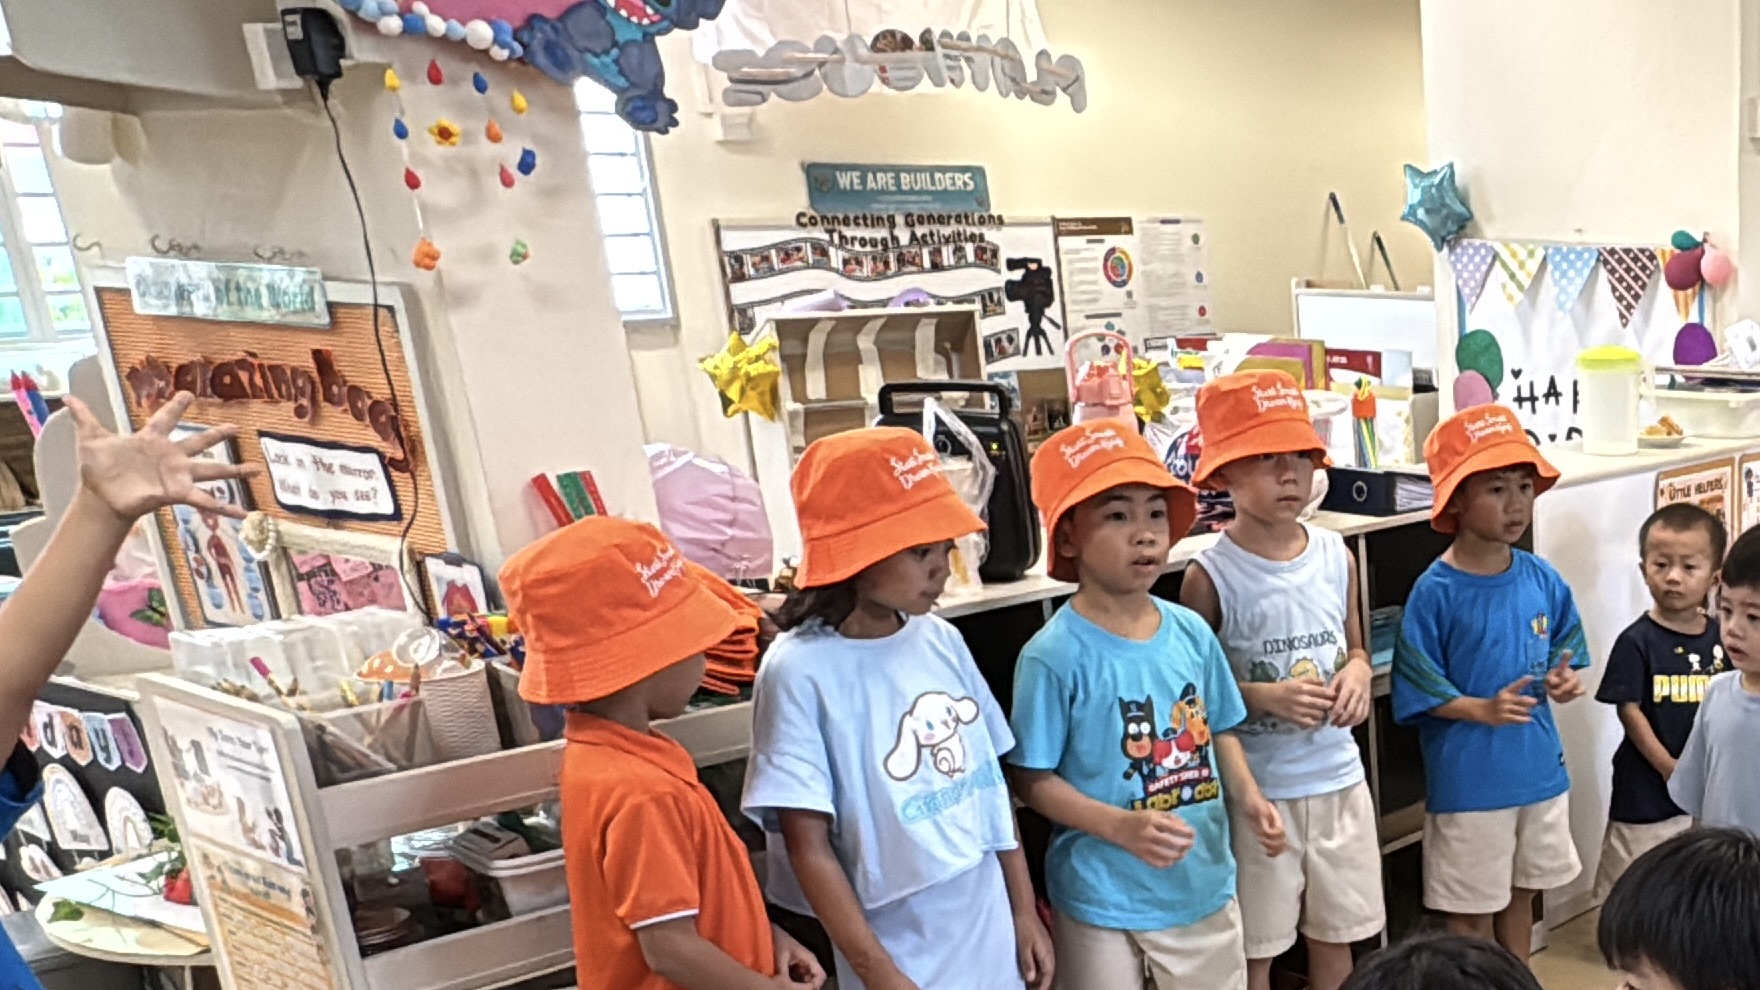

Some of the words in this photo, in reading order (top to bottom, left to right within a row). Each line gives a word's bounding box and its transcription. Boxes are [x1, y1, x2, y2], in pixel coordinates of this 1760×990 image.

[835, 171, 862, 191] WE
[866, 171, 898, 191] ARE
[900, 171, 976, 192] BUILDERS
[795, 211, 897, 229] Connecting
[903, 211, 1005, 228] Generations
[827, 228, 900, 251] Through
[908, 229, 986, 246] Activities
[1262, 629, 1338, 656] DINOSAURS
[1652, 674, 1712, 703] PUM
